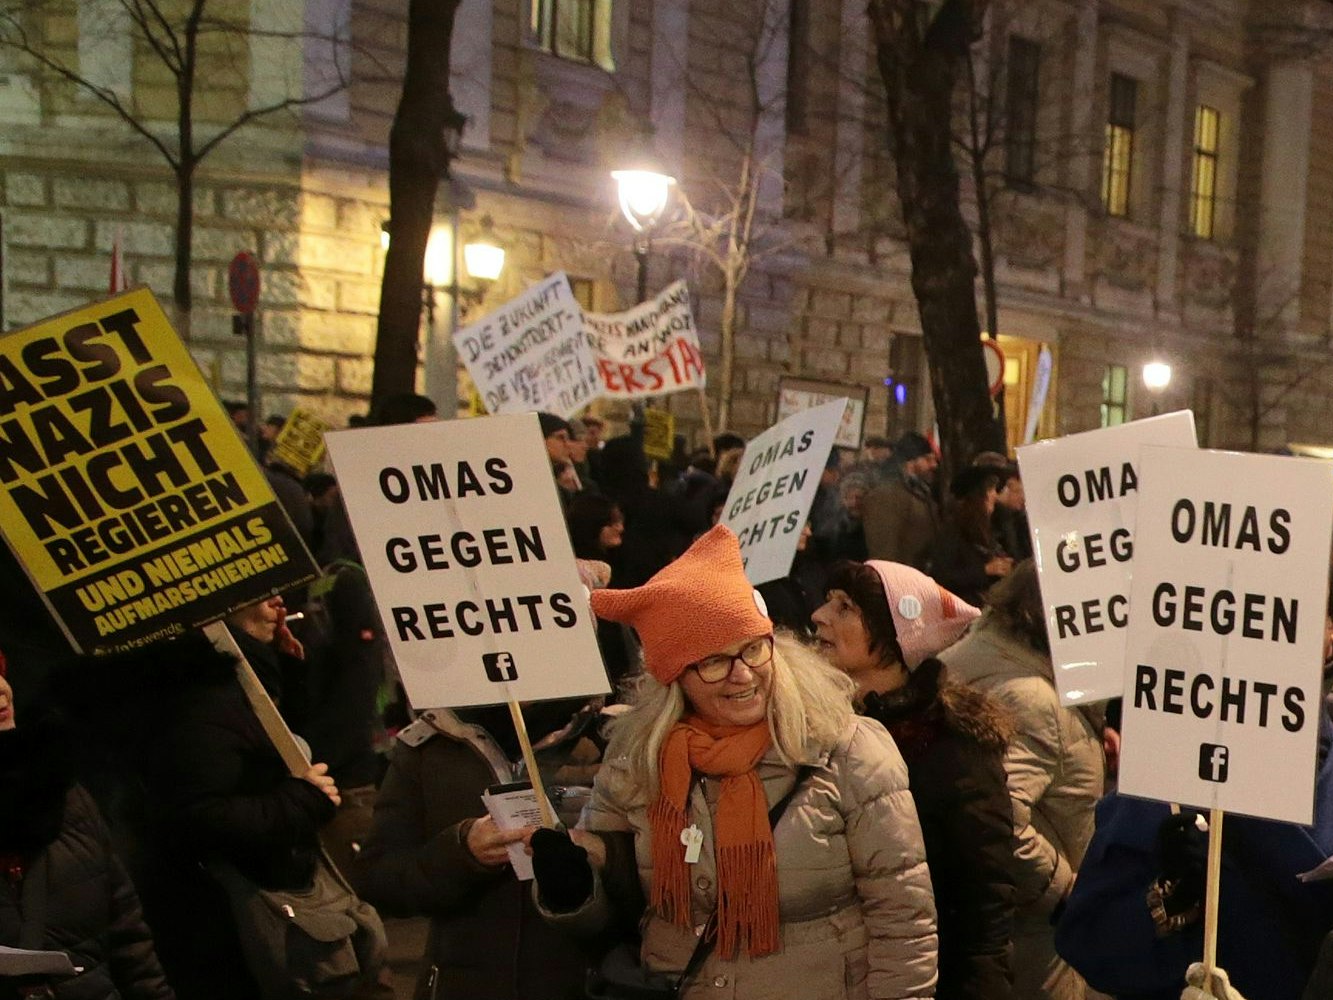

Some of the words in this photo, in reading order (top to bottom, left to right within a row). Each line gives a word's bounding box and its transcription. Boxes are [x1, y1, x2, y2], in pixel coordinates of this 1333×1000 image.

[0, 364, 191, 483] NAZIS
[750, 430, 815, 475] OMAS
[8, 418, 222, 541] NICHT
[379, 457, 513, 504] OMAS
[729, 469, 808, 521] GEGEN
[43, 471, 250, 577] REGIEREN
[385, 526, 547, 573] GEGEN
[1171, 499, 1291, 554] OMAS
[75, 569, 145, 613] UND
[141, 516, 273, 588] NIEMALS
[93, 543, 290, 637] AUFMARSCHIEREN!
[391, 593, 577, 642] RECHTS
[1152, 582, 1299, 644] GEGEN
[1134, 664, 1305, 732] RECHTS
